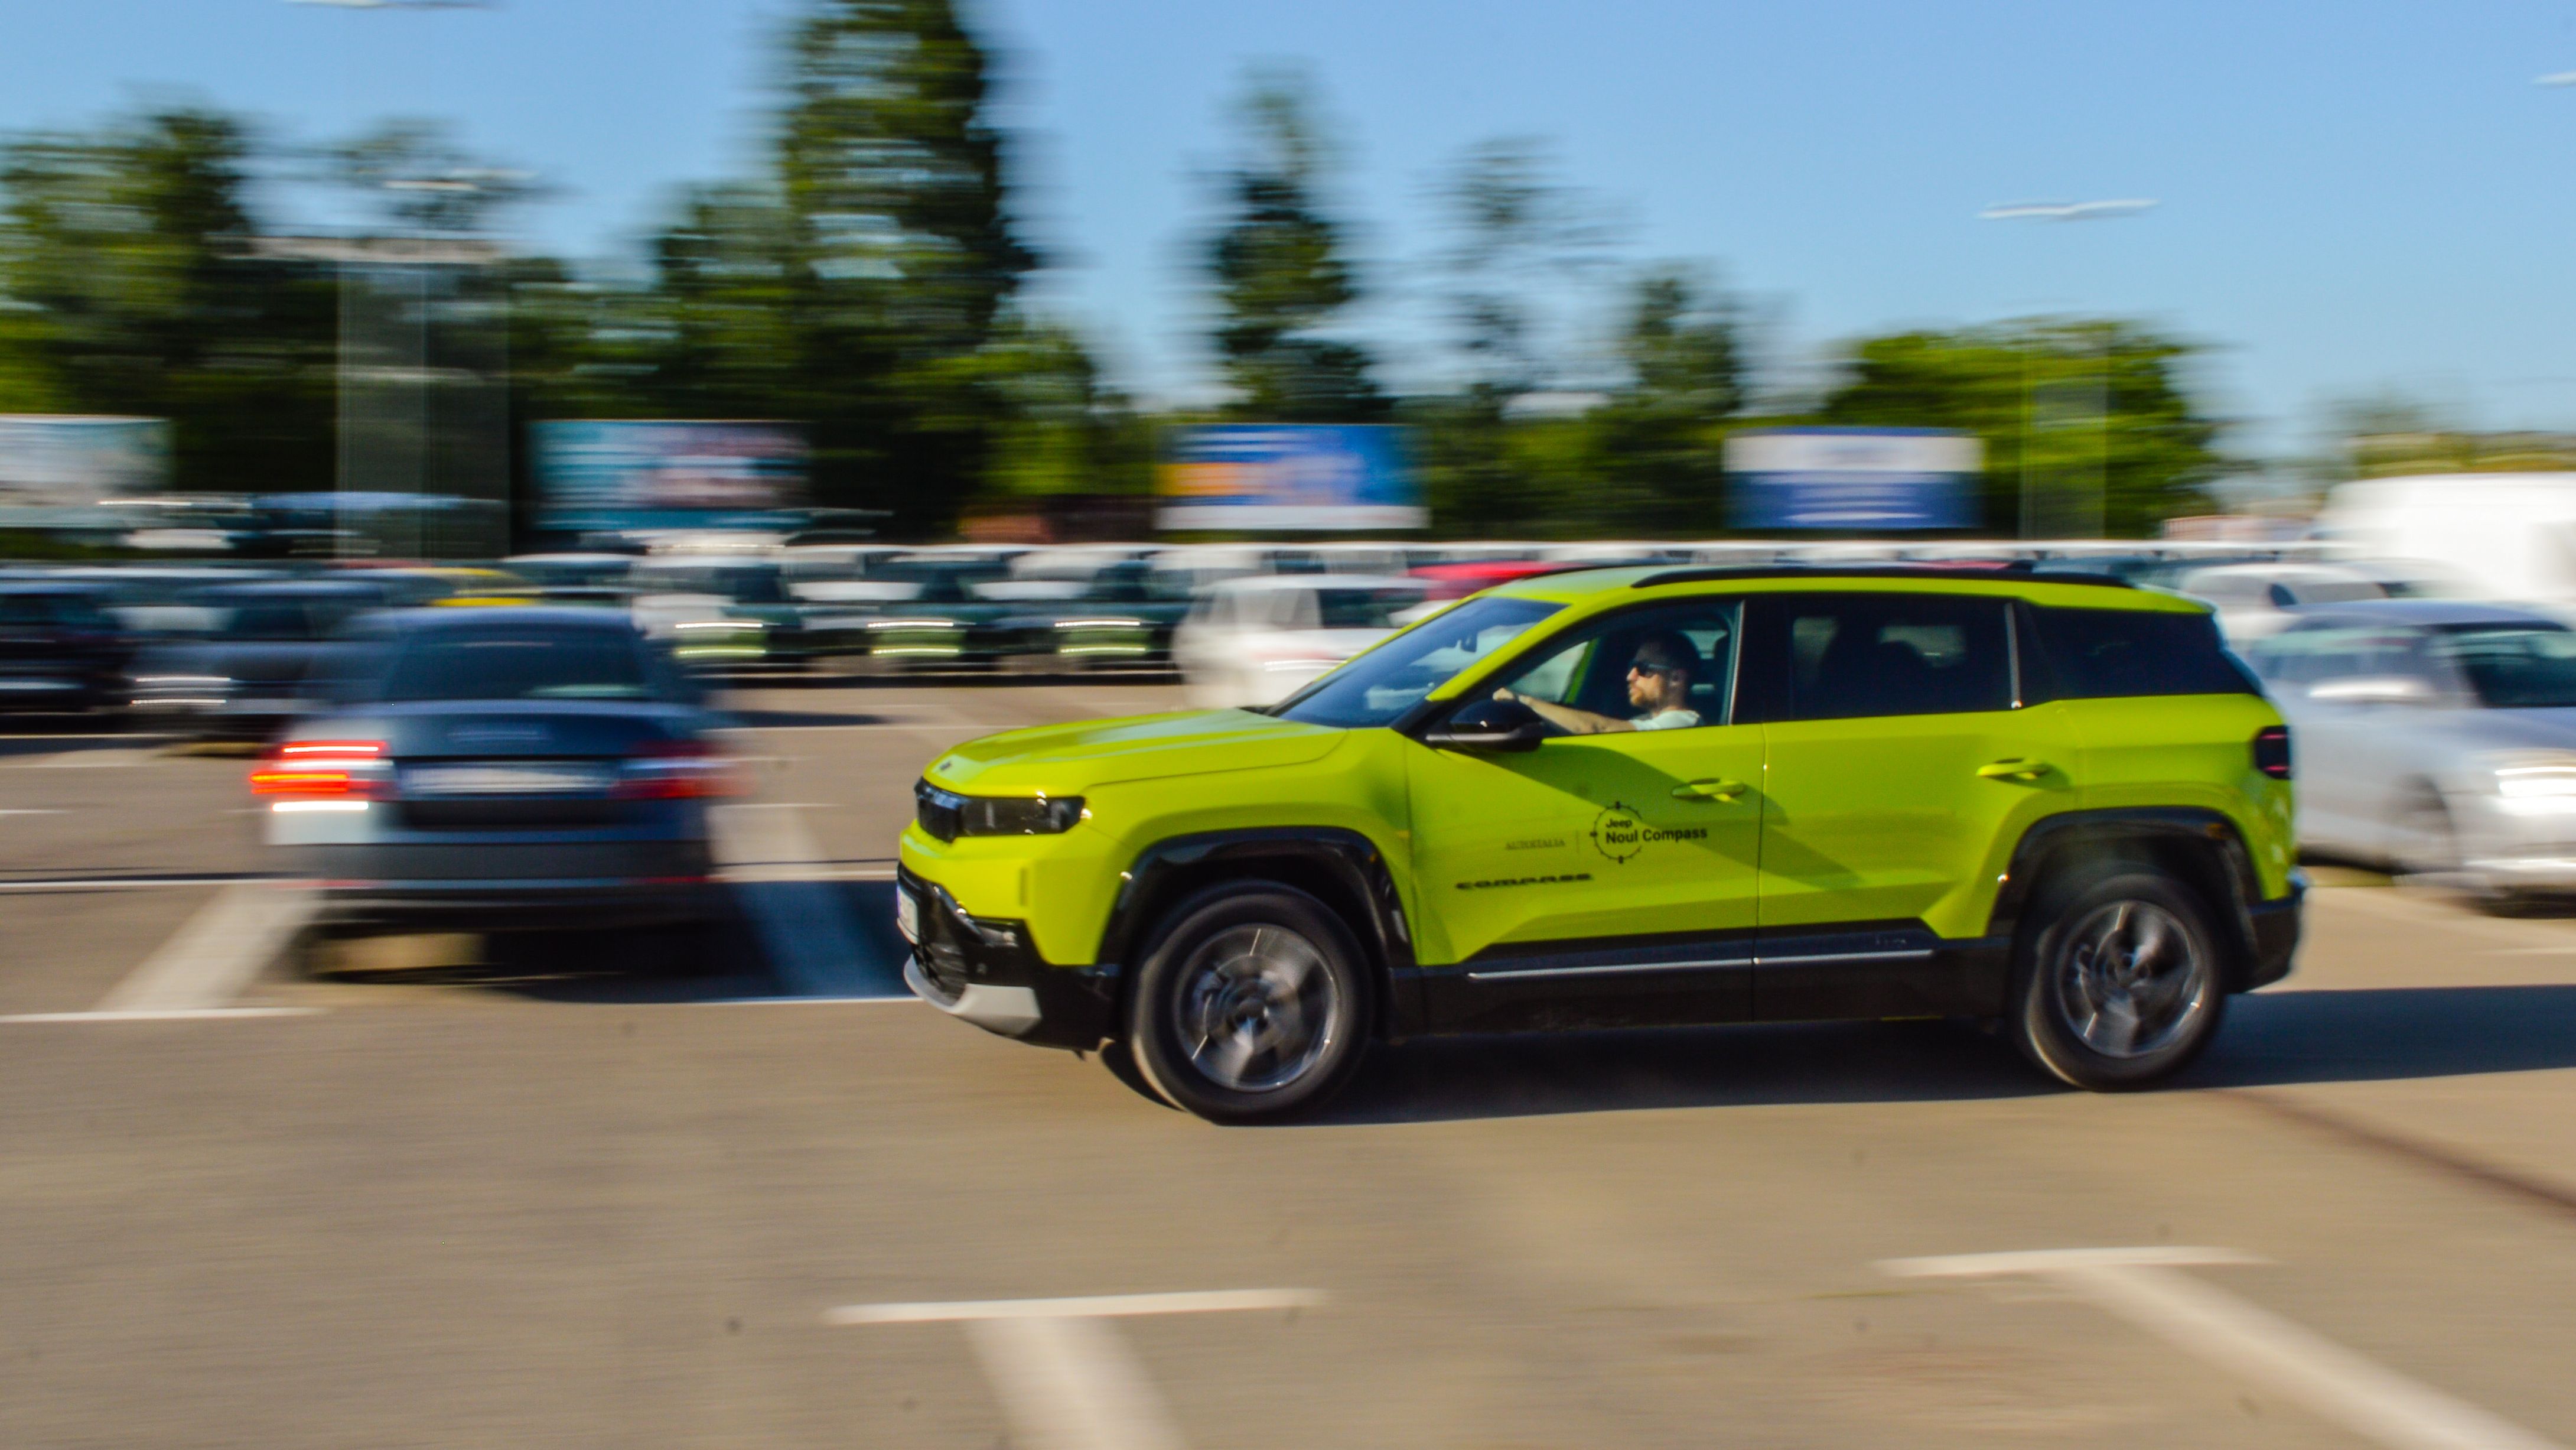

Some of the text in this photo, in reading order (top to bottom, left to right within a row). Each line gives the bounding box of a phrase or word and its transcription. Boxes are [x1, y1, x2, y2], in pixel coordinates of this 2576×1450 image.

[1606, 819, 1633, 828] Jeep
[1606, 828, 1708, 843] Noul Compass
